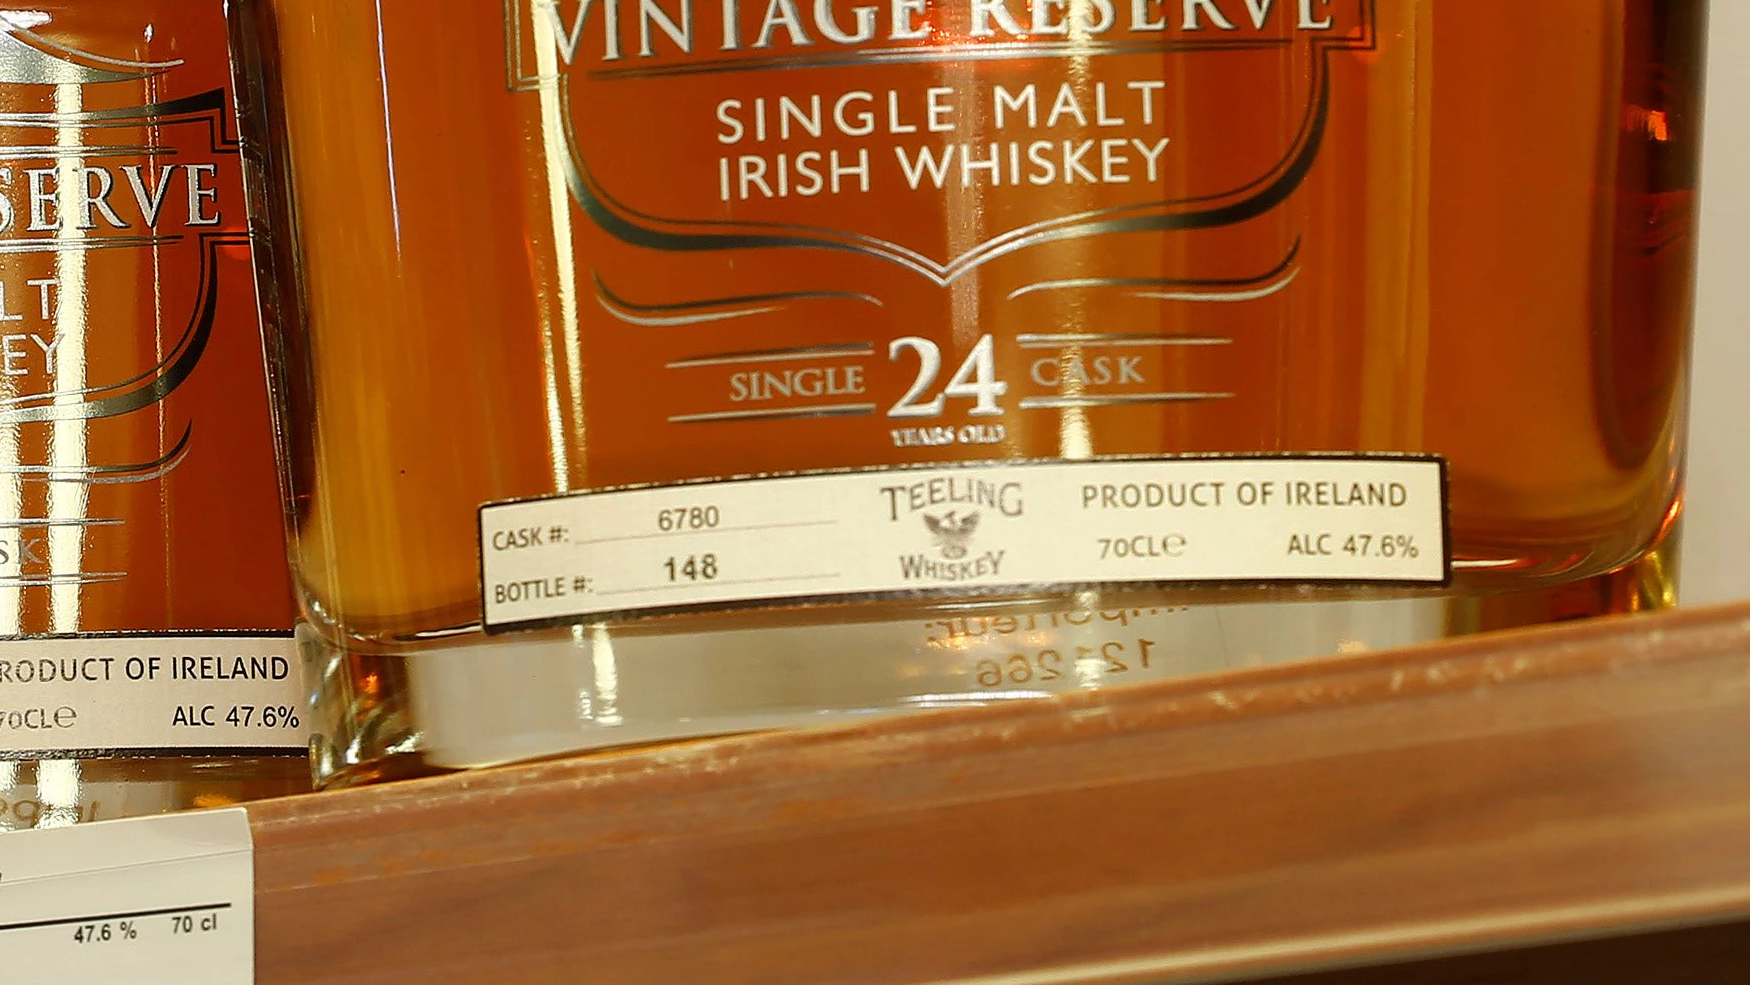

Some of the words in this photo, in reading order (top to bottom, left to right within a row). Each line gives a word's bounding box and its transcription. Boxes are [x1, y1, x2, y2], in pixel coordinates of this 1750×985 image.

[717, 87, 954, 144] SINGLE
[995, 81, 1166, 127] MALT
[720, 149, 870, 201] IRISH
[894, 137, 1170, 189] WHISKEY
[730, 366, 866, 402] SINGLE
[887, 333, 1008, 417] 24
[1030, 355, 1146, 387] CASK
[890, 426, 954, 447] YEARS
[957, 424, 1006, 444] OLD
[880, 477, 1024, 521] TEELING
[1082, 482, 1223, 509] PRODUCT
[1236, 481, 1274, 506] OF
[1286, 481, 1407, 507] IRELAND
[493, 527, 542, 551] CASK
[549, 526, 569, 544] #:
[658, 506, 720, 531] 6780
[1287, 533, 1332, 556] ALC
[1342, 534, 1419, 559] 47.6%
[495, 577, 566, 604] BOTTLE
[573, 574, 593, 594] #:
[664, 555, 718, 582] 148
[900, 550, 1005, 581] WHISKEY
[125, 657, 162, 681] OF
[172, 657, 289, 681] IRELAND
[172, 706, 215, 727] ALC
[226, 706, 300, 730] 47.6%
[74, 925, 111, 944] 47.6
[119, 921, 138, 940] %
[171, 917, 193, 935] 70
[201, 914, 218, 932] cl
